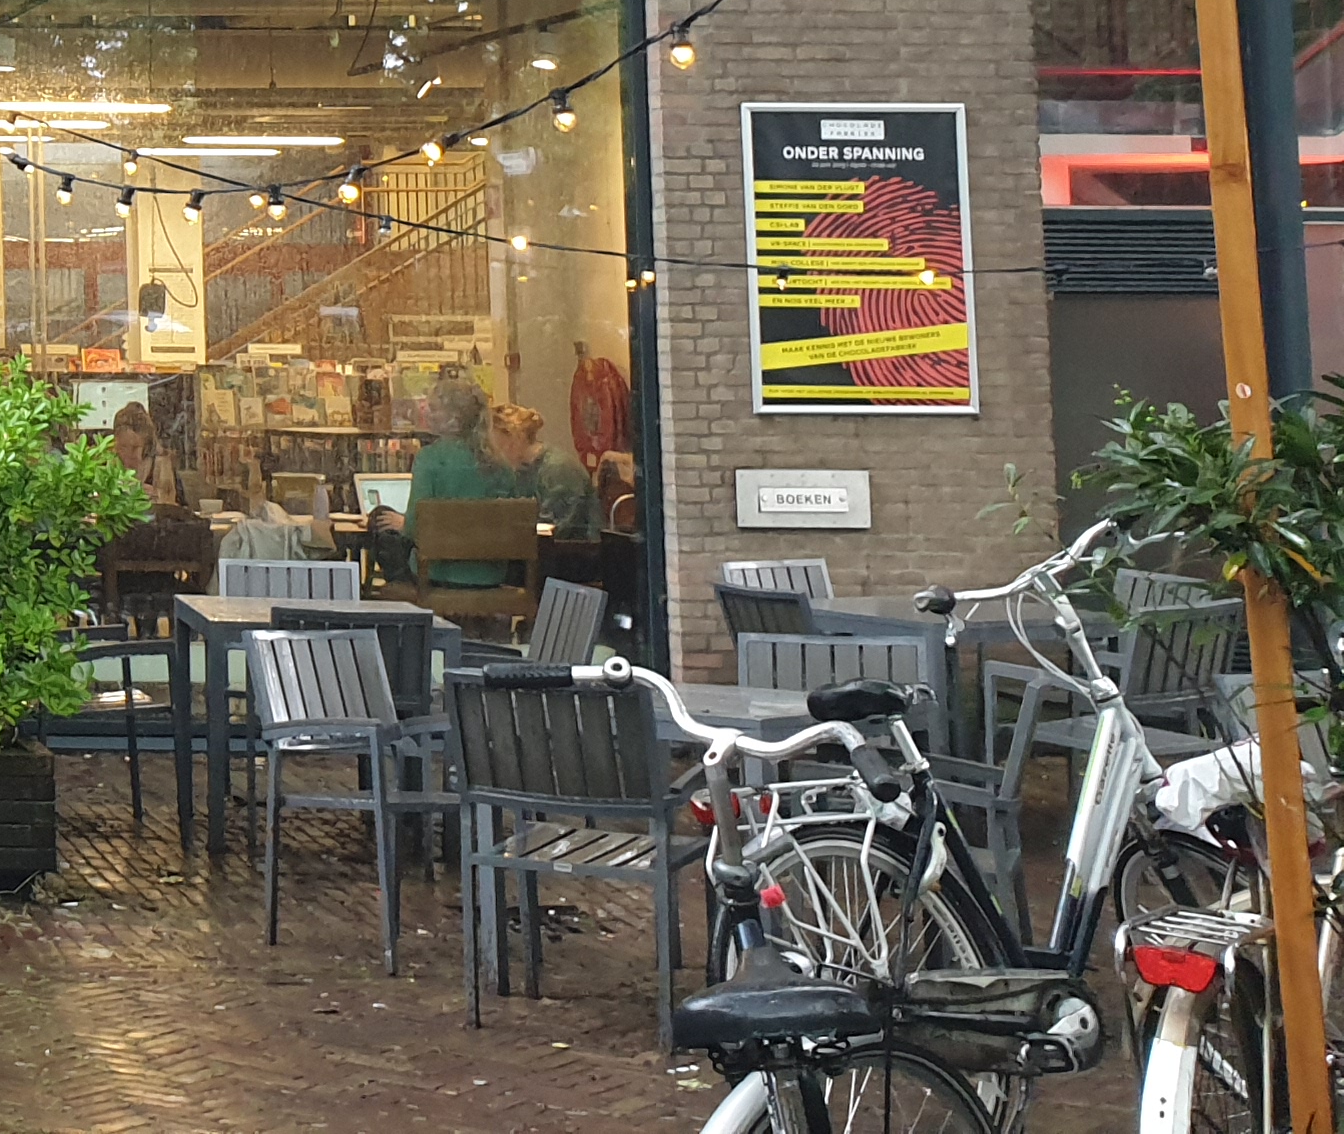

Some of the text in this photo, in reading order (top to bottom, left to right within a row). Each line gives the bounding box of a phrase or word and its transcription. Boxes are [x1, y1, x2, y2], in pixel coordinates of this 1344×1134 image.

[782, 145, 925, 161] ONDER SPANNING
[775, 492, 832, 506] BOEKEN
